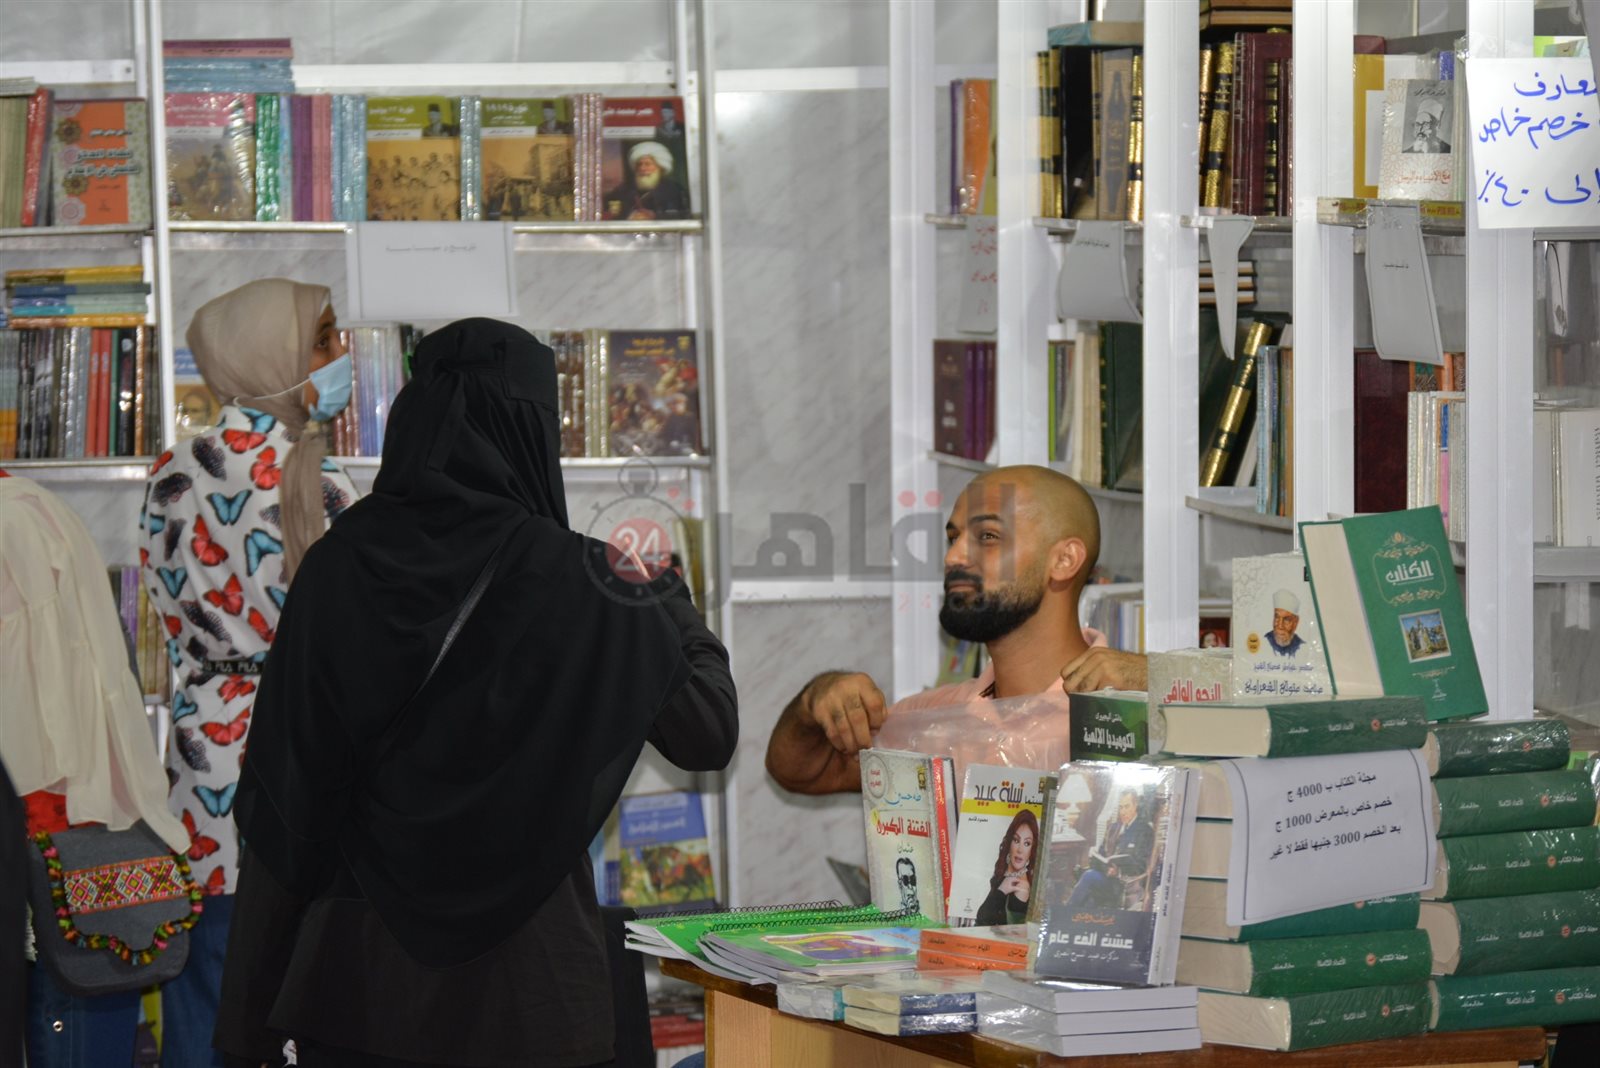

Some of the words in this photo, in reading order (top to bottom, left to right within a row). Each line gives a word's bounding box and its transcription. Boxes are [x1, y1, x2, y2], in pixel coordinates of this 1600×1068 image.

[1479, 106, 1531, 143] خاص
[1527, 112, 1590, 149] خصم
[1385, 560, 1434, 586] الكتاب
[1335, 774, 1356, 789] الكتاب
[974, 784, 997, 807] عبيد
[999, 780, 1025, 809] نبيلة
[1287, 790, 1294, 802] ج
[1297, 782, 1323, 798] 4000
[884, 791, 912, 807] حسين
[1373, 796, 1392, 811] خصم
[1315, 806, 1349, 823] بالمعرض
[1352, 801, 1372, 816] خاص
[876, 816, 904, 836] الكبرى
[907, 818, 931, 838] الفتنة
[1275, 820, 1282, 832] ج
[1286, 813, 1312, 829] 1000
[1389, 824, 1401, 834] بعد
[1334, 831, 1360, 846] 3000
[1363, 825, 1387, 840] الخصم
[1286, 842, 1292, 854] لا
[1294, 839, 1308, 851] فقط
[1311, 836, 1331, 851] جنيها
[1269, 844, 1283, 860] غير
[1048, 930, 1070, 945] عام
[1100, 933, 1134, 949] عشت
